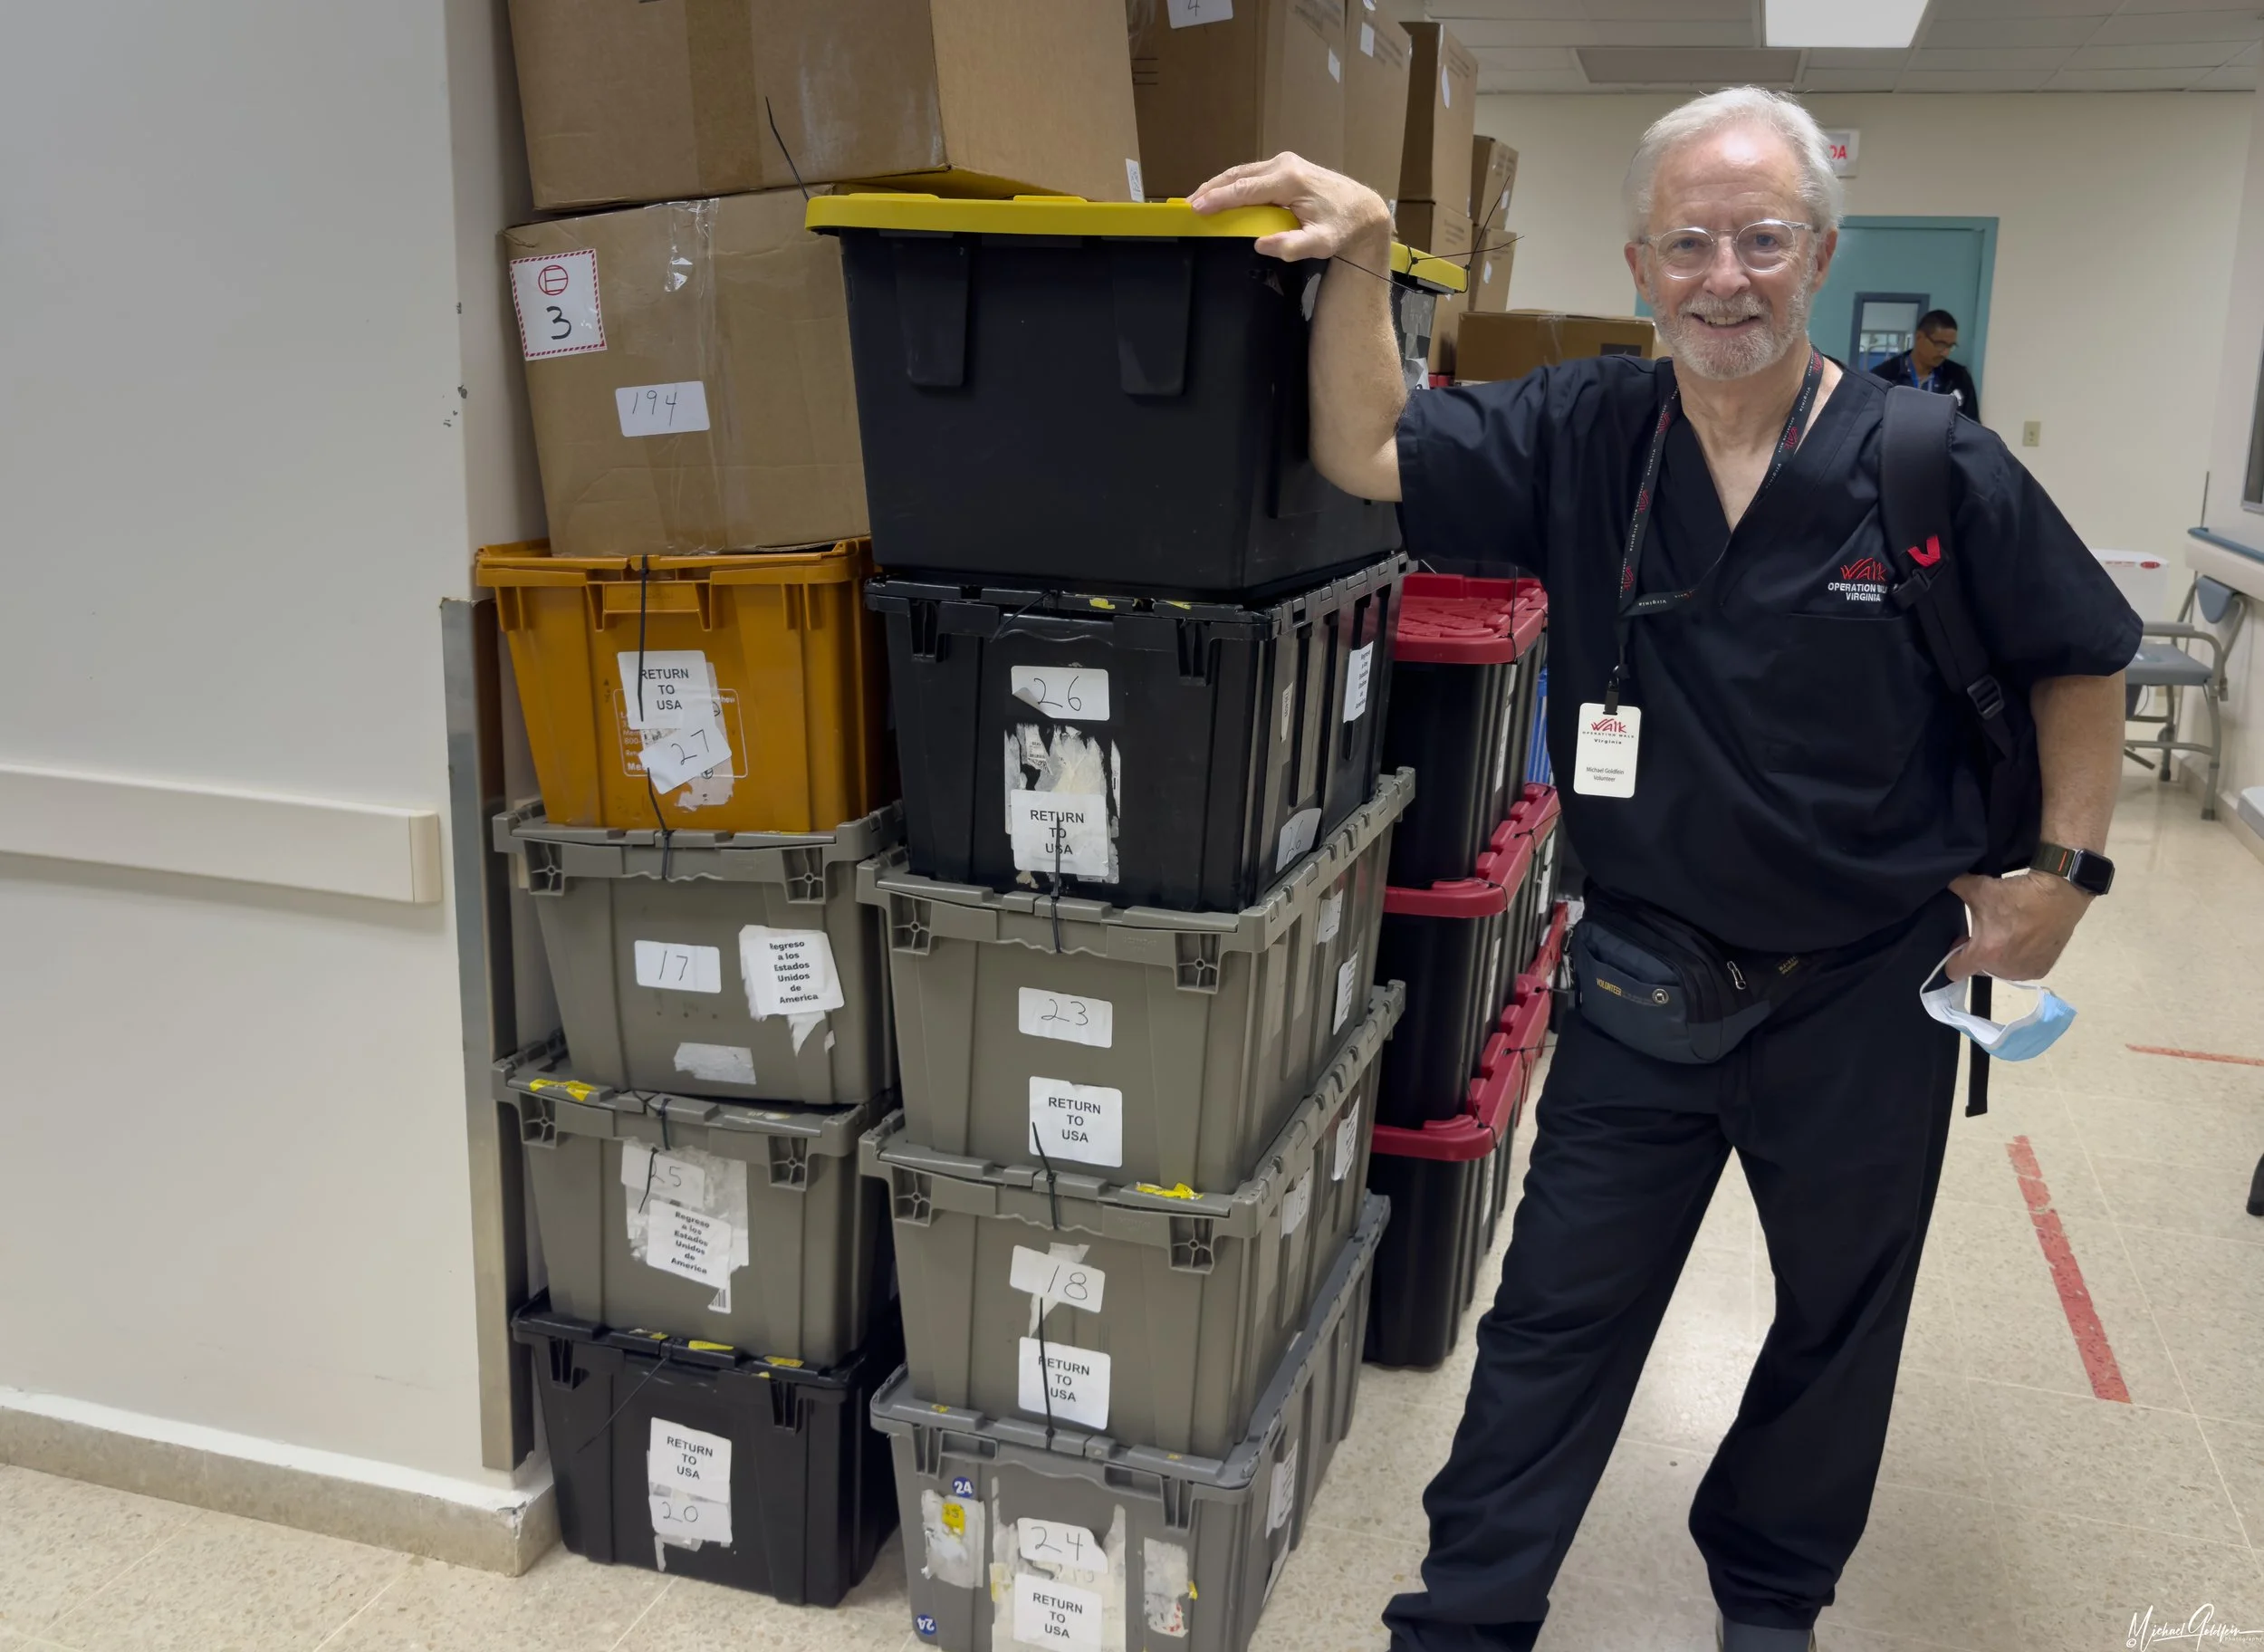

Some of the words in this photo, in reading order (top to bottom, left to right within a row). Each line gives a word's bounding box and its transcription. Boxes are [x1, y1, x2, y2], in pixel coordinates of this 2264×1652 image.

[546, 305, 571, 340] 3
[632, 390, 677, 426] 194
[1828, 582, 1876, 593] OPERATION
[1846, 591, 1881, 602] VIRGINIA
[639, 668, 689, 680] RETURN
[657, 685, 676, 696] TO
[1033, 676, 1082, 711] 26
[657, 700, 683, 711] USA
[671, 729, 709, 765] 27
[1030, 810, 1085, 823] RETURN
[1049, 827, 1067, 839] TO
[1045, 843, 1073, 855] USA
[769, 940, 805, 952] Regreso
[785, 952, 800, 960] los
[659, 950, 688, 981] 17
[773, 962, 811, 972] Estados
[778, 973, 811, 983] Unidos
[790, 984, 801, 993] de
[1596, 977, 1622, 997] VOLUNTEER
[779, 993, 819, 1004] America
[1041, 999, 1089, 1026] 23
[1048, 1097, 1101, 1115] RETURN
[1067, 1114, 1084, 1127] TO
[1061, 1129, 1089, 1143] USA
[675, 1211, 710, 1228] Regreso
[689, 1225, 703, 1236] los
[674, 1230, 709, 1247] Estados
[676, 1240, 705, 1255] Unidos
[684, 1253, 696, 1261] de
[671, 1258, 707, 1275] America
[1048, 1265, 1088, 1301] 18
[1055, 1374, 1072, 1387] TO
[1050, 1388, 1077, 1402] USA
[667, 1436, 714, 1457] RETURN
[681, 1453, 697, 1465] TO
[676, 1465, 700, 1480] USA
[661, 1502, 699, 1523] 20
[1031, 1526, 1084, 1561] 24
[1032, 1592, 1084, 1615] RETURN
[1049, 1610, 1067, 1625] TO
[1044, 1623, 1071, 1639] USA
